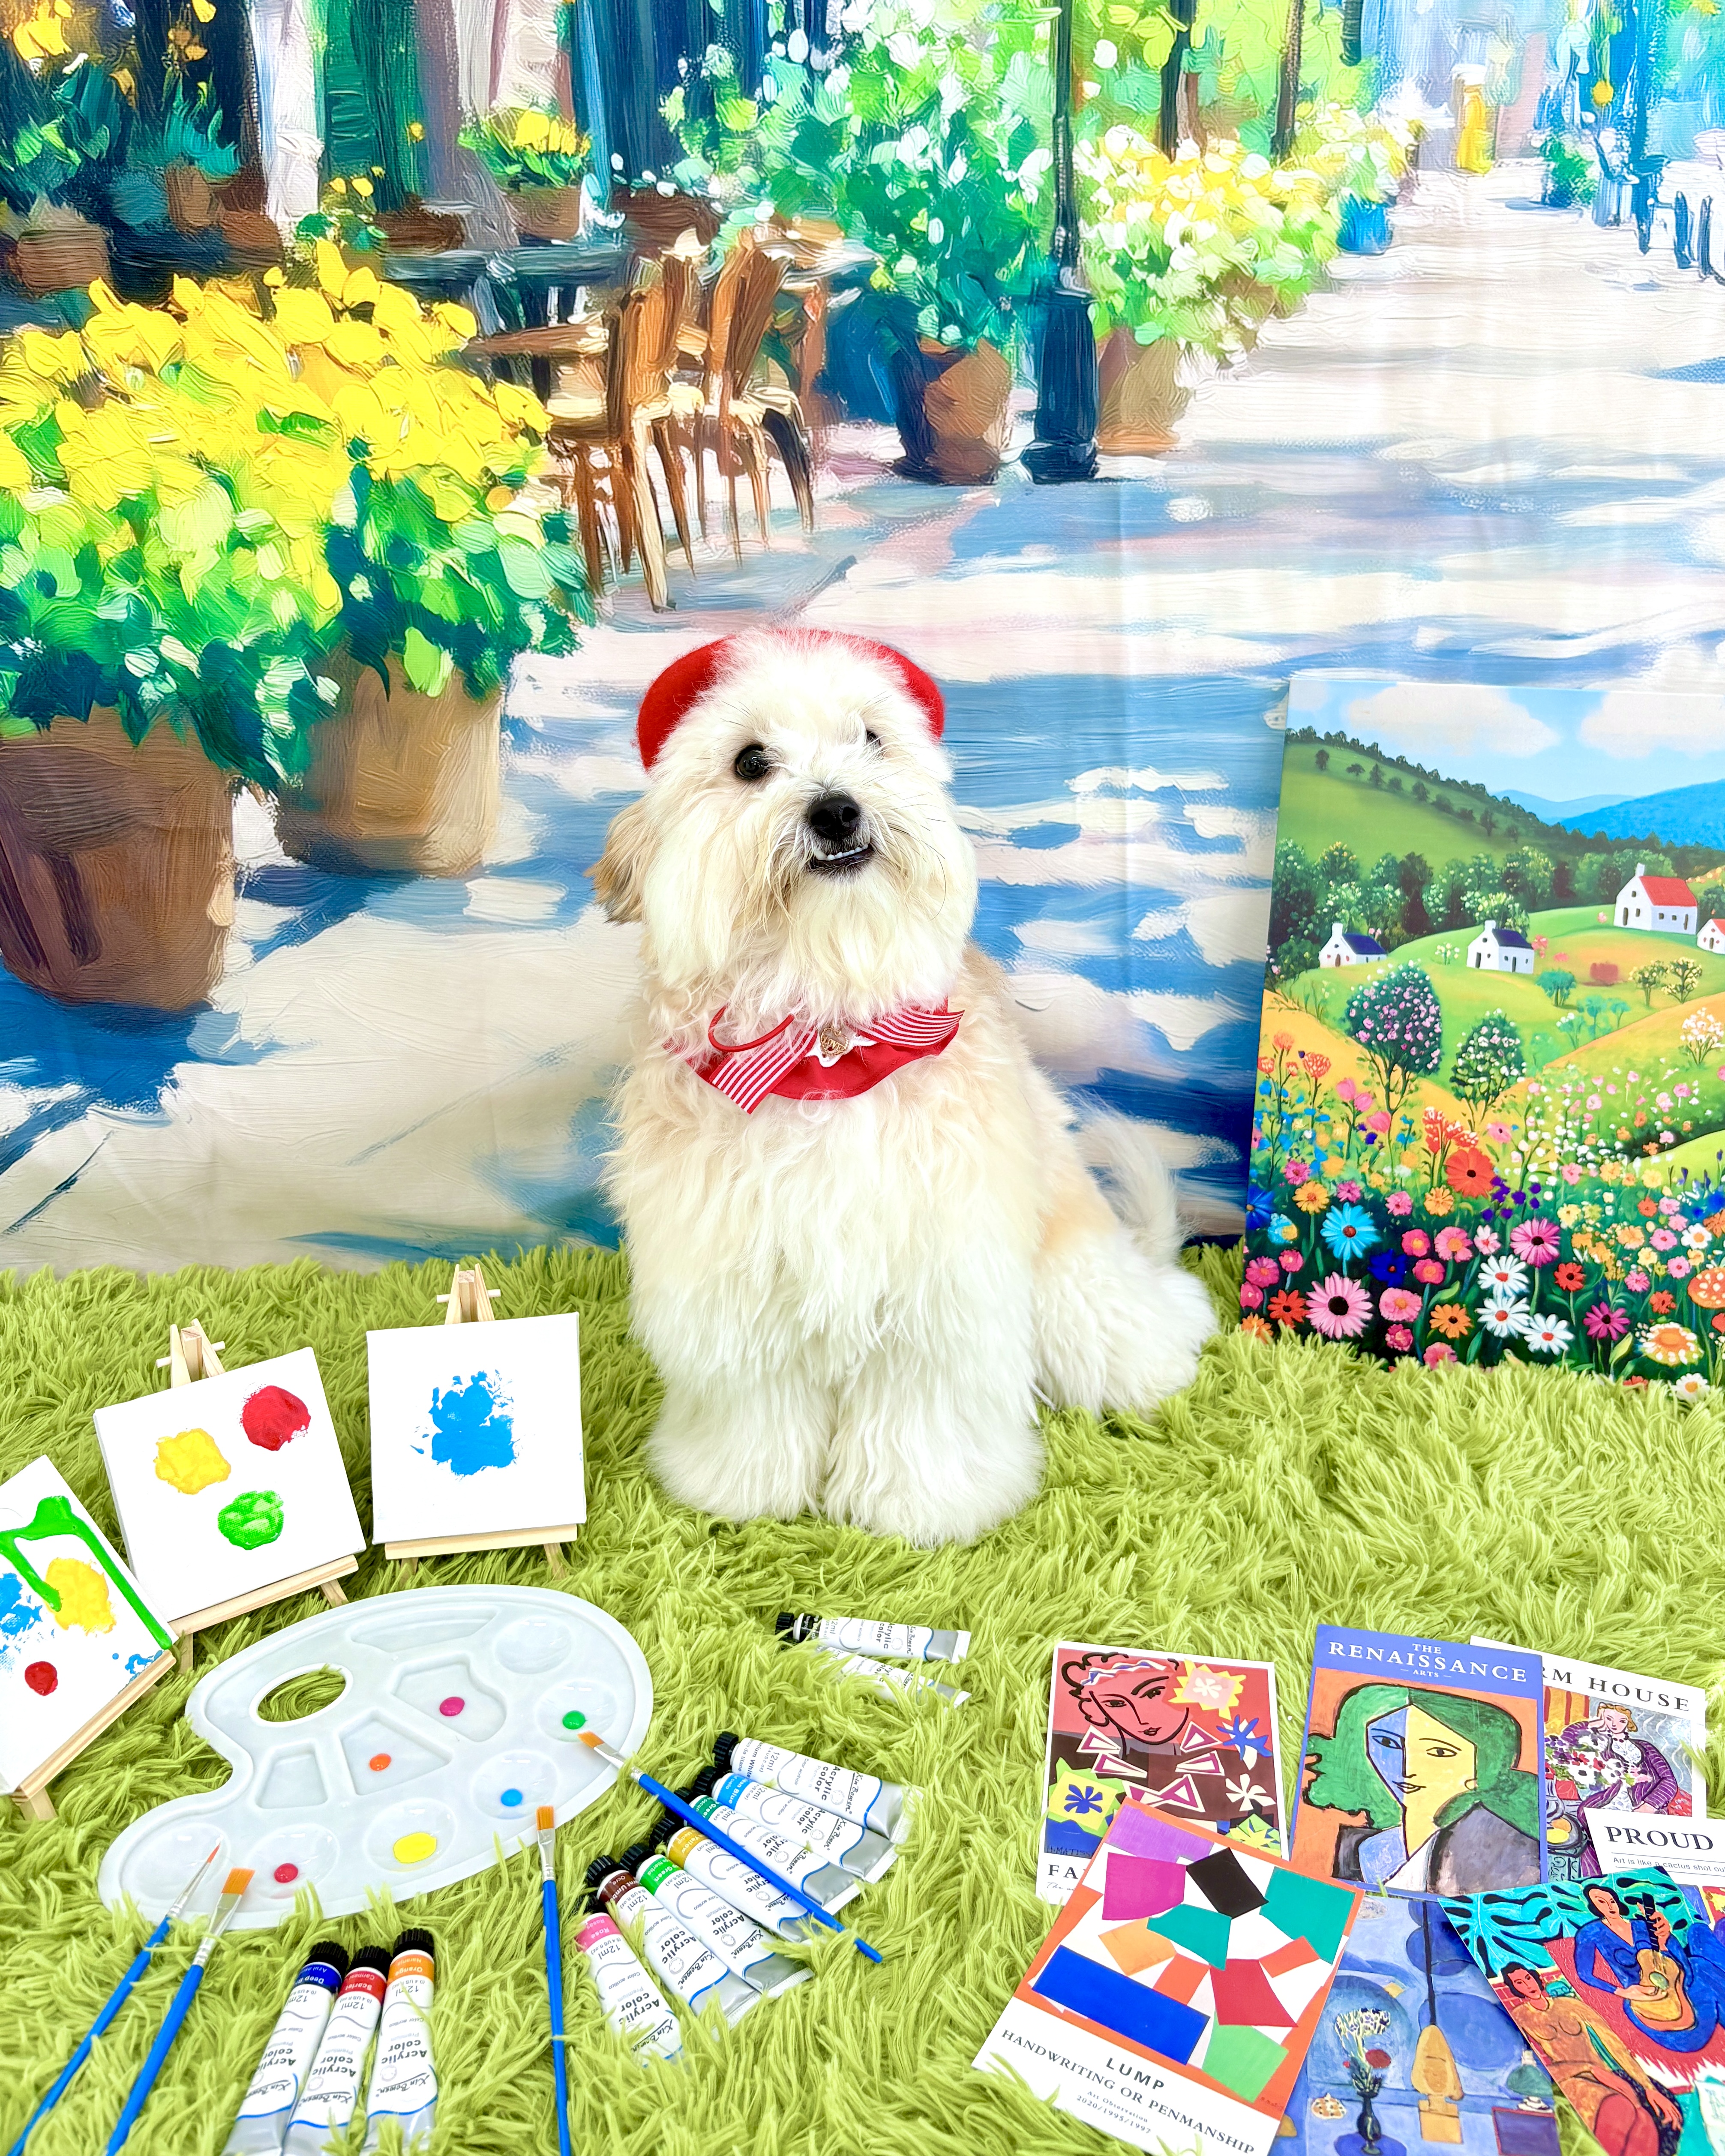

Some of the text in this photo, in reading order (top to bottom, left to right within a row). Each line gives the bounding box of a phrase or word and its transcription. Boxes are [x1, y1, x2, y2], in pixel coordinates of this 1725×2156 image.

[829, 1618, 839, 1634] 12ml
[876, 1623, 885, 1643] color
[883, 1622, 895, 1649] Acrylic
[1412, 1643, 1442, 1655] THE
[1328, 1641, 1527, 1682] RENAISSANCE
[1588, 1676, 1689, 1712] HOUSE
[746, 1759, 756, 1778] White
[766, 1751, 780, 1771] 12ml
[814, 1766, 828, 1792] color
[821, 1766, 841, 1801] Acrylic
[728, 1788, 740, 1805] Blue
[752, 1786, 768, 1800] 12ml
[721, 1810, 736, 1821] 2ml
[797, 1806, 814, 1826] color
[801, 1808, 826, 1834] Acrylic
[681, 1835, 700, 1853] Yellow
[1604, 1826, 1713, 1850] PROUD
[705, 1844, 720, 1853] 2ml
[766, 1838, 788, 1857] crylic
[1047, 1845, 1092, 1857] H.MATISS
[612, 1875, 626, 1885] Ocre
[654, 1866, 673, 1882] Green
[744, 1874, 761, 1884] olor
[673, 1876, 693, 1889] 12ml
[746, 1879, 771, 1892] crylic
[612, 1884, 627, 1900] Umb
[627, 1894, 648, 1912] 12ml
[711, 1910, 734, 1925] color
[713, 1914, 745, 1935] Acrylic
[591, 1927, 610, 1939] Rose
[660, 1931, 686, 1952] color
[598, 1944, 621, 1960] 12ml
[662, 1936, 697, 1964] Acrylic
[395, 1966, 423, 1976] Orange
[627, 1971, 640, 1979] Color
[304, 1975, 324, 1984] Deep
[345, 1982, 373, 1991] Scarlet
[286, 1994, 308, 2006] 12ml
[617, 1986, 644, 2002] Premium
[621, 1992, 650, 2012] color
[341, 2001, 365, 2010] 12ml
[618, 1998, 660, 2024] Acrylic
[388, 2039, 421, 2052] color
[263, 2048, 293, 2060] color
[320, 2056, 354, 2064] color
[381, 2050, 428, 2064] Acrylic
[312, 2063, 357, 2078] Acrylic
[1106, 2057, 1165, 2090] LUMP
[1001, 2029, 1255, 2154] HANDWRITING OR PENMANSHIP
[1076, 2095, 1152, 2134] 2020/1995/1997
[1087, 2091, 1148, 2123] Art Observation
